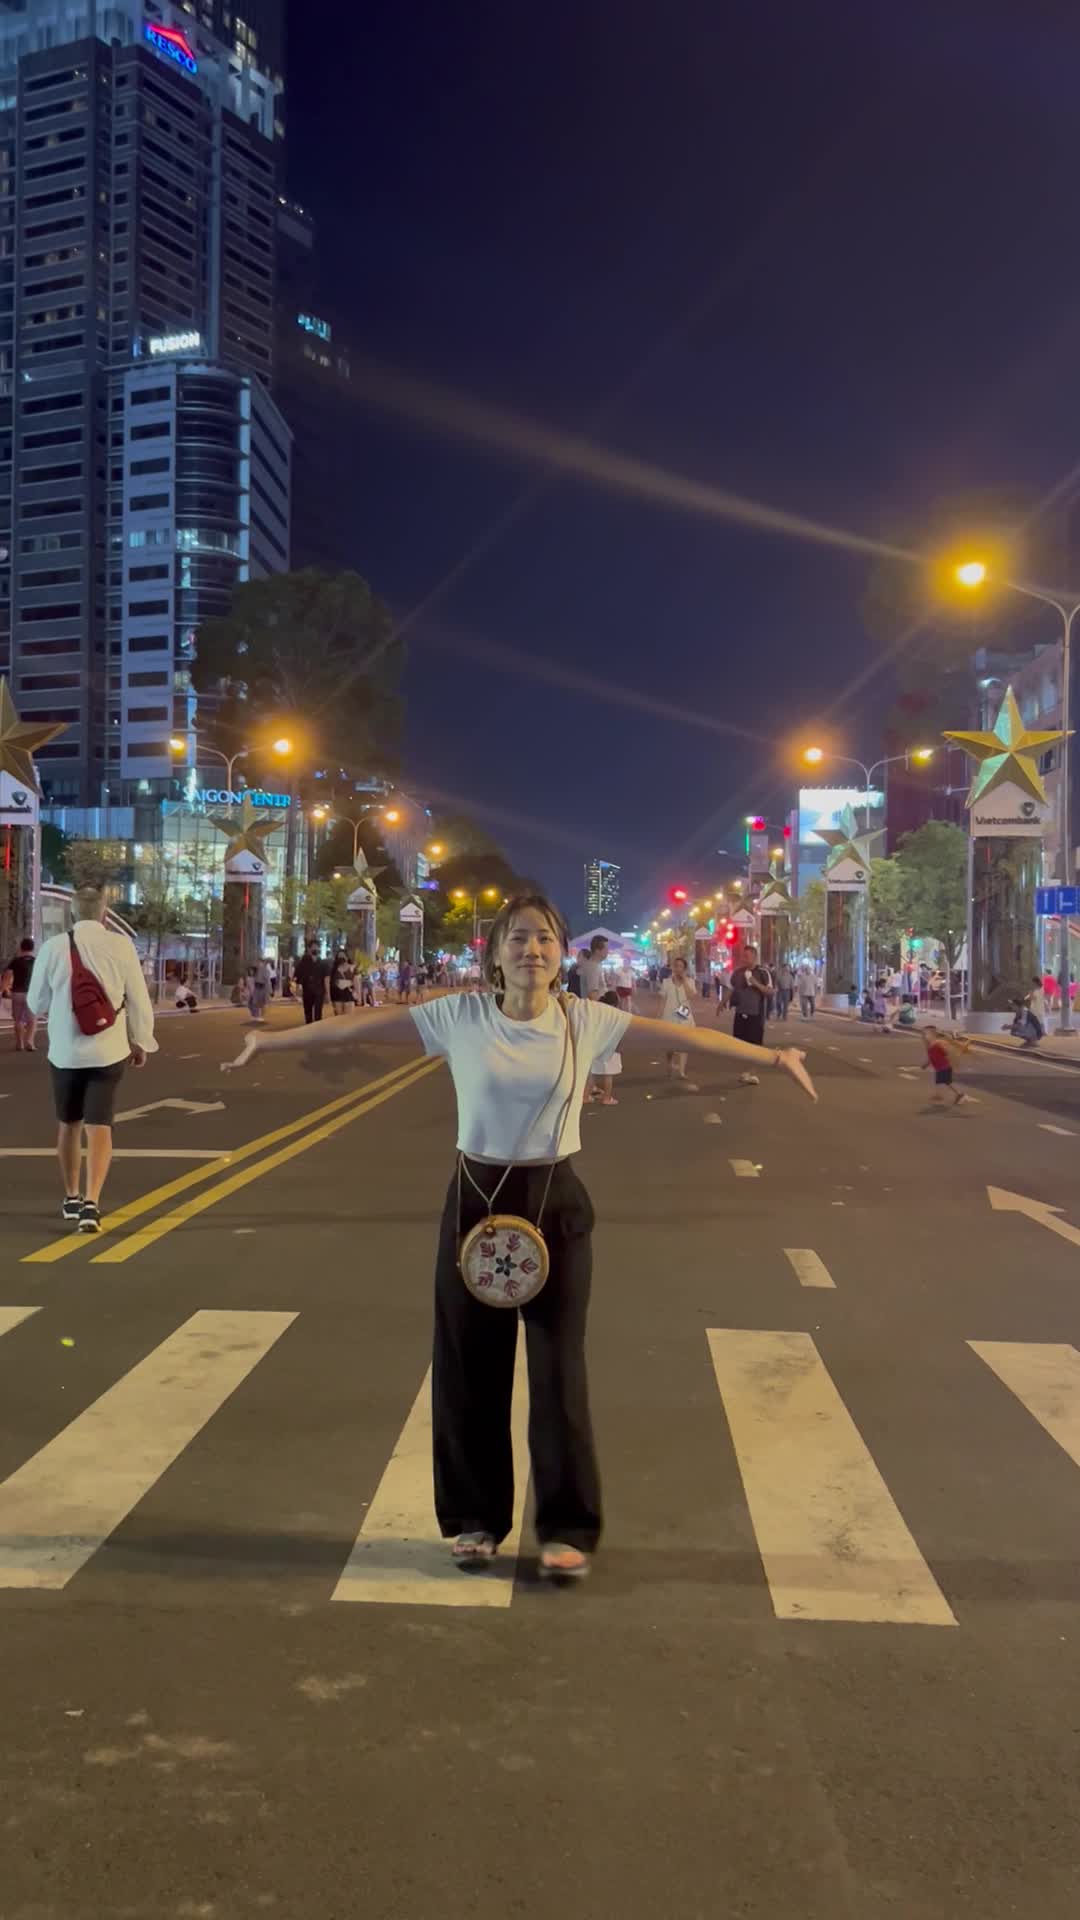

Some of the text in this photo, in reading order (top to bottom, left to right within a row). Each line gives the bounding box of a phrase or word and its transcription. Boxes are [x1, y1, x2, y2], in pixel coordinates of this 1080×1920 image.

[144, 27, 198, 75] RESCO
[150, 330, 200, 354] FUSION
[183, 787, 242, 804] SAIGON
[975, 816, 1041, 825] Vietcombank
